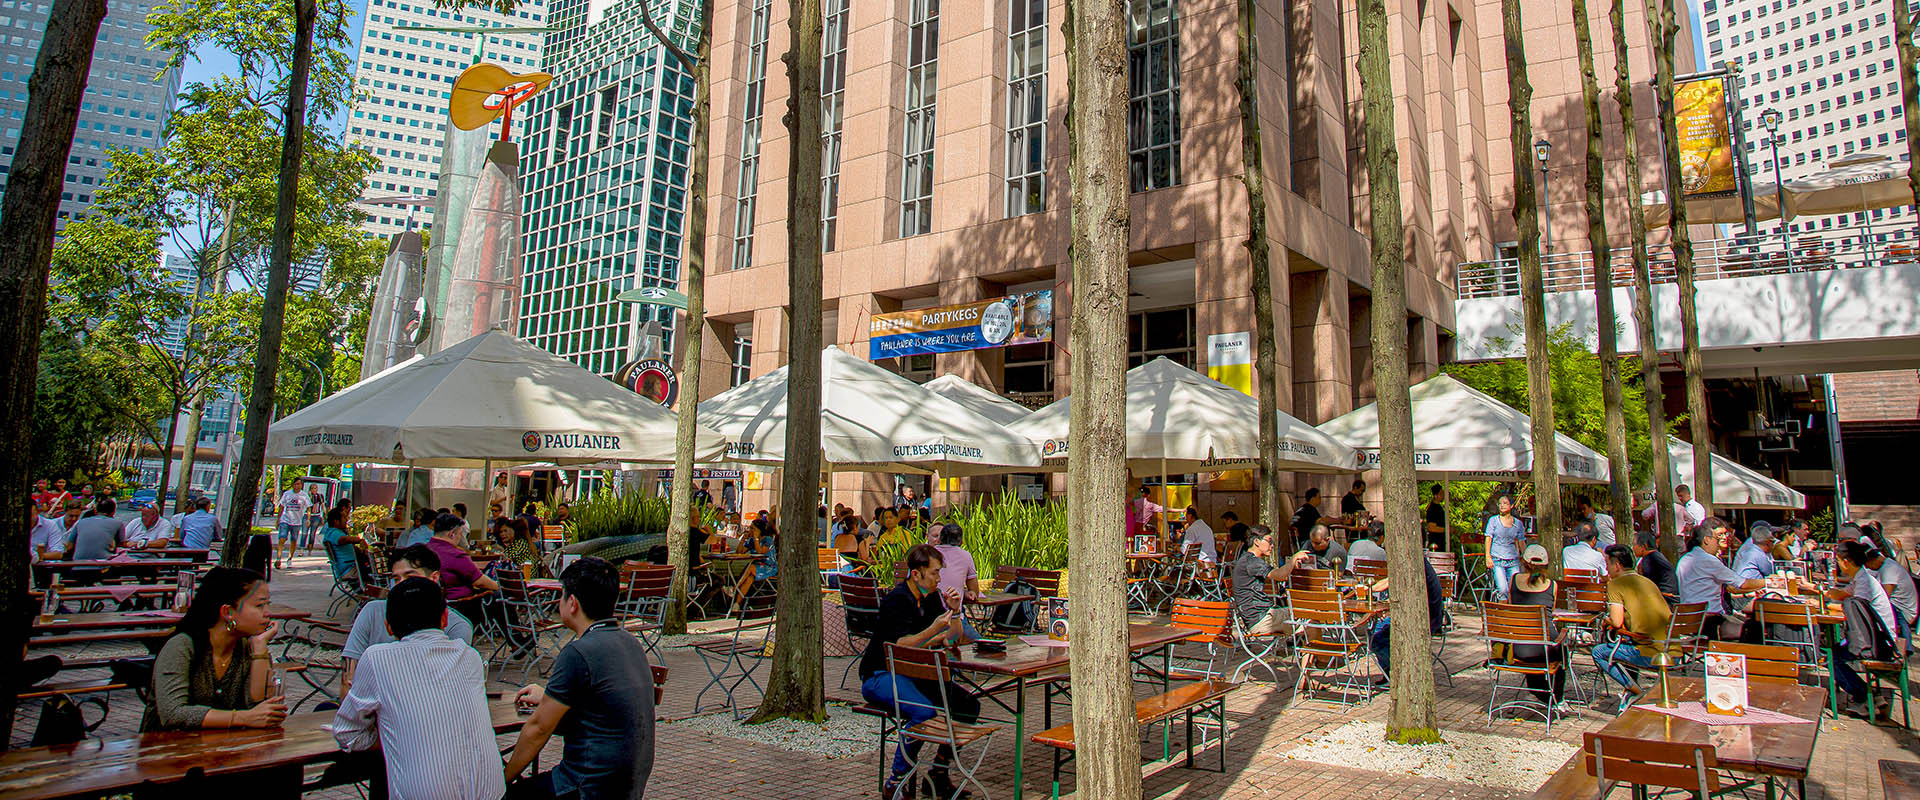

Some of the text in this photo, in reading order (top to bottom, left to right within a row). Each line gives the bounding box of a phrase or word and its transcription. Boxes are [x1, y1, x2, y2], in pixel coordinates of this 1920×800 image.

[1844, 172, 1890, 184] PAULANER
[922, 307, 978, 325] PARTYKEGS
[881, 338, 912, 350] PAULANER
[915, 337, 920, 346] IS
[922, 335, 945, 346] WHERE
[946, 334, 960, 344] YOU
[1215, 340, 1243, 348] PAULANER
[630, 361, 676, 384] PAULANER
[544, 434, 621, 450] PAULANER
